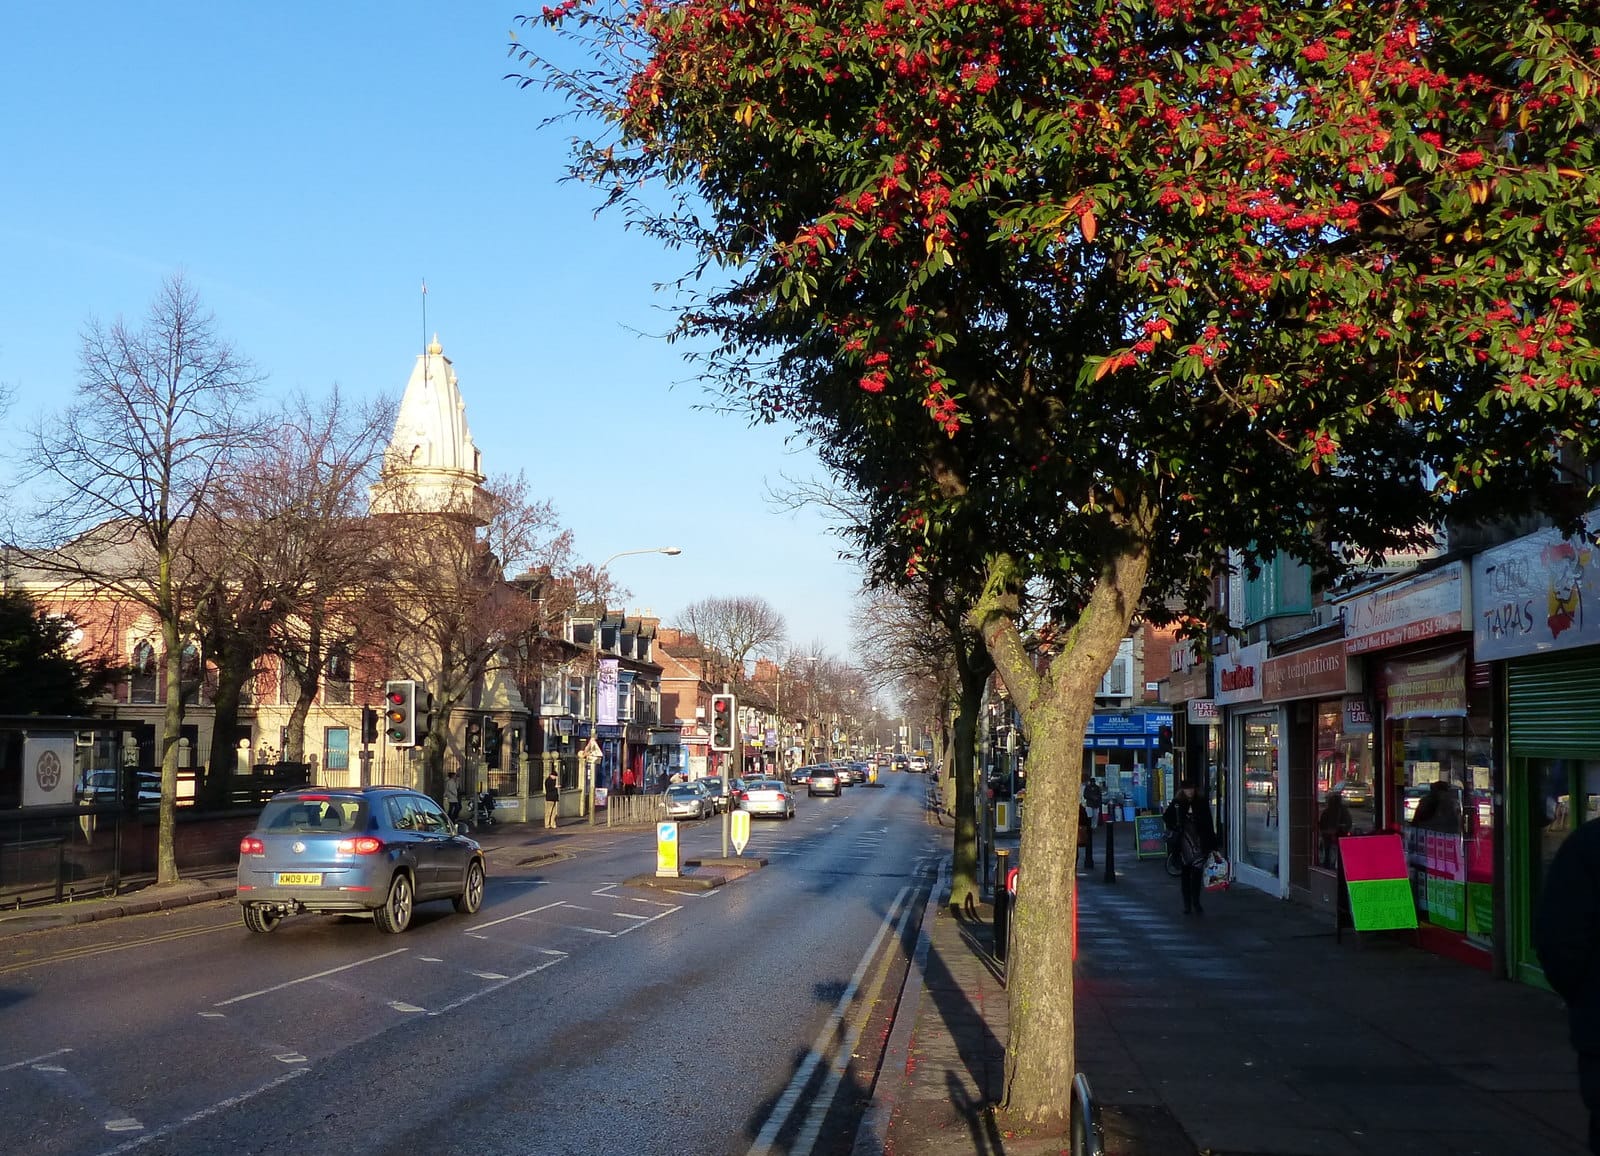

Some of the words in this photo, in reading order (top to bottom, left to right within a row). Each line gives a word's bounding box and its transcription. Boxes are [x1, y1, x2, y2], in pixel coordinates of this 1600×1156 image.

[1421, 620, 1433, 635] 254
[1484, 600, 1533, 640] TAPAS
[1287, 653, 1340, 685] temptations
[303, 875, 320, 883] VJP
